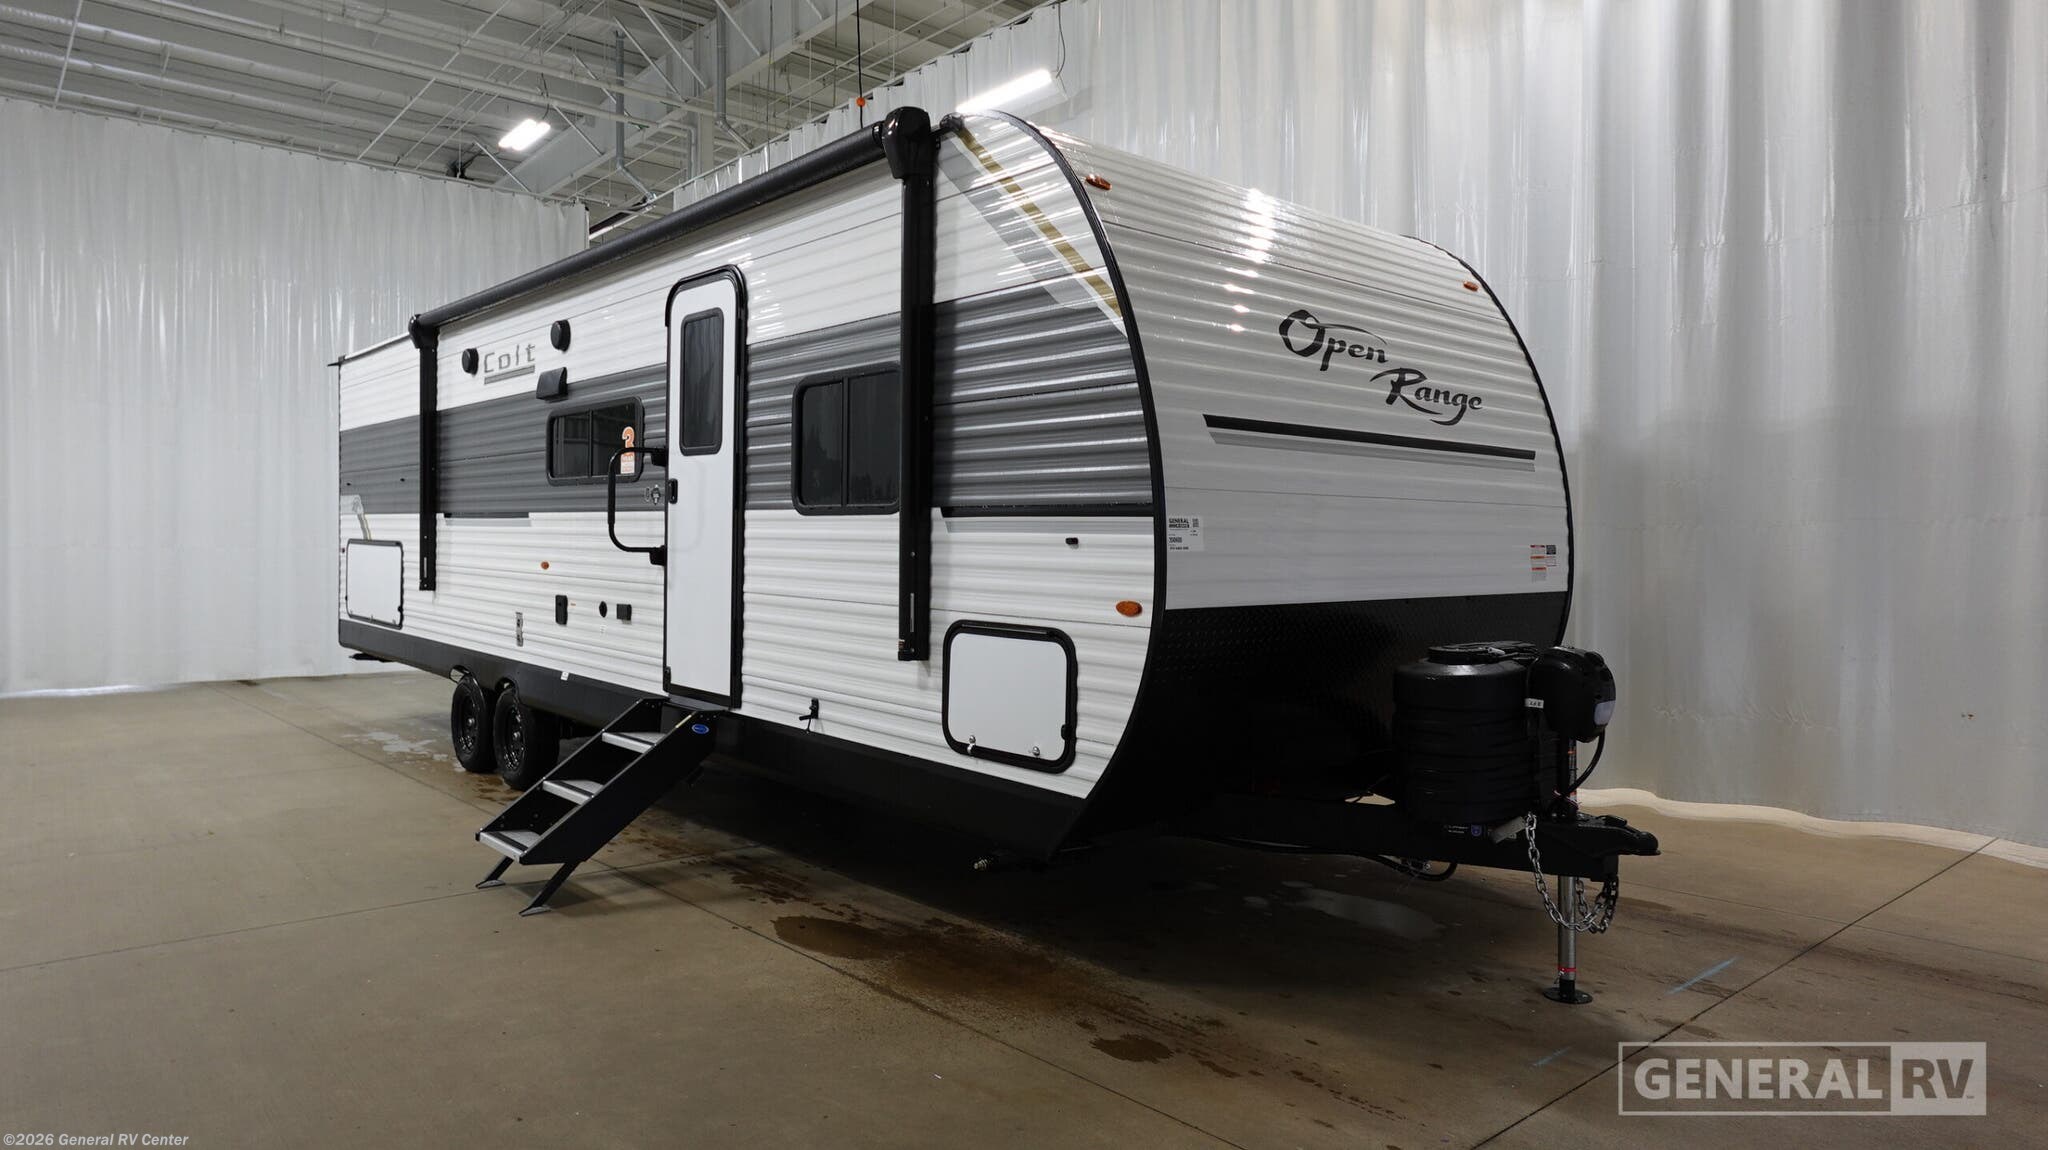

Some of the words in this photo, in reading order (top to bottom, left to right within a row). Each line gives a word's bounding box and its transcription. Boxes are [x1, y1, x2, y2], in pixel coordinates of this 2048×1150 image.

[484, 344, 535, 373] Colt
[1279, 309, 1388, 371] Open
[1370, 367, 1483, 425] Range
